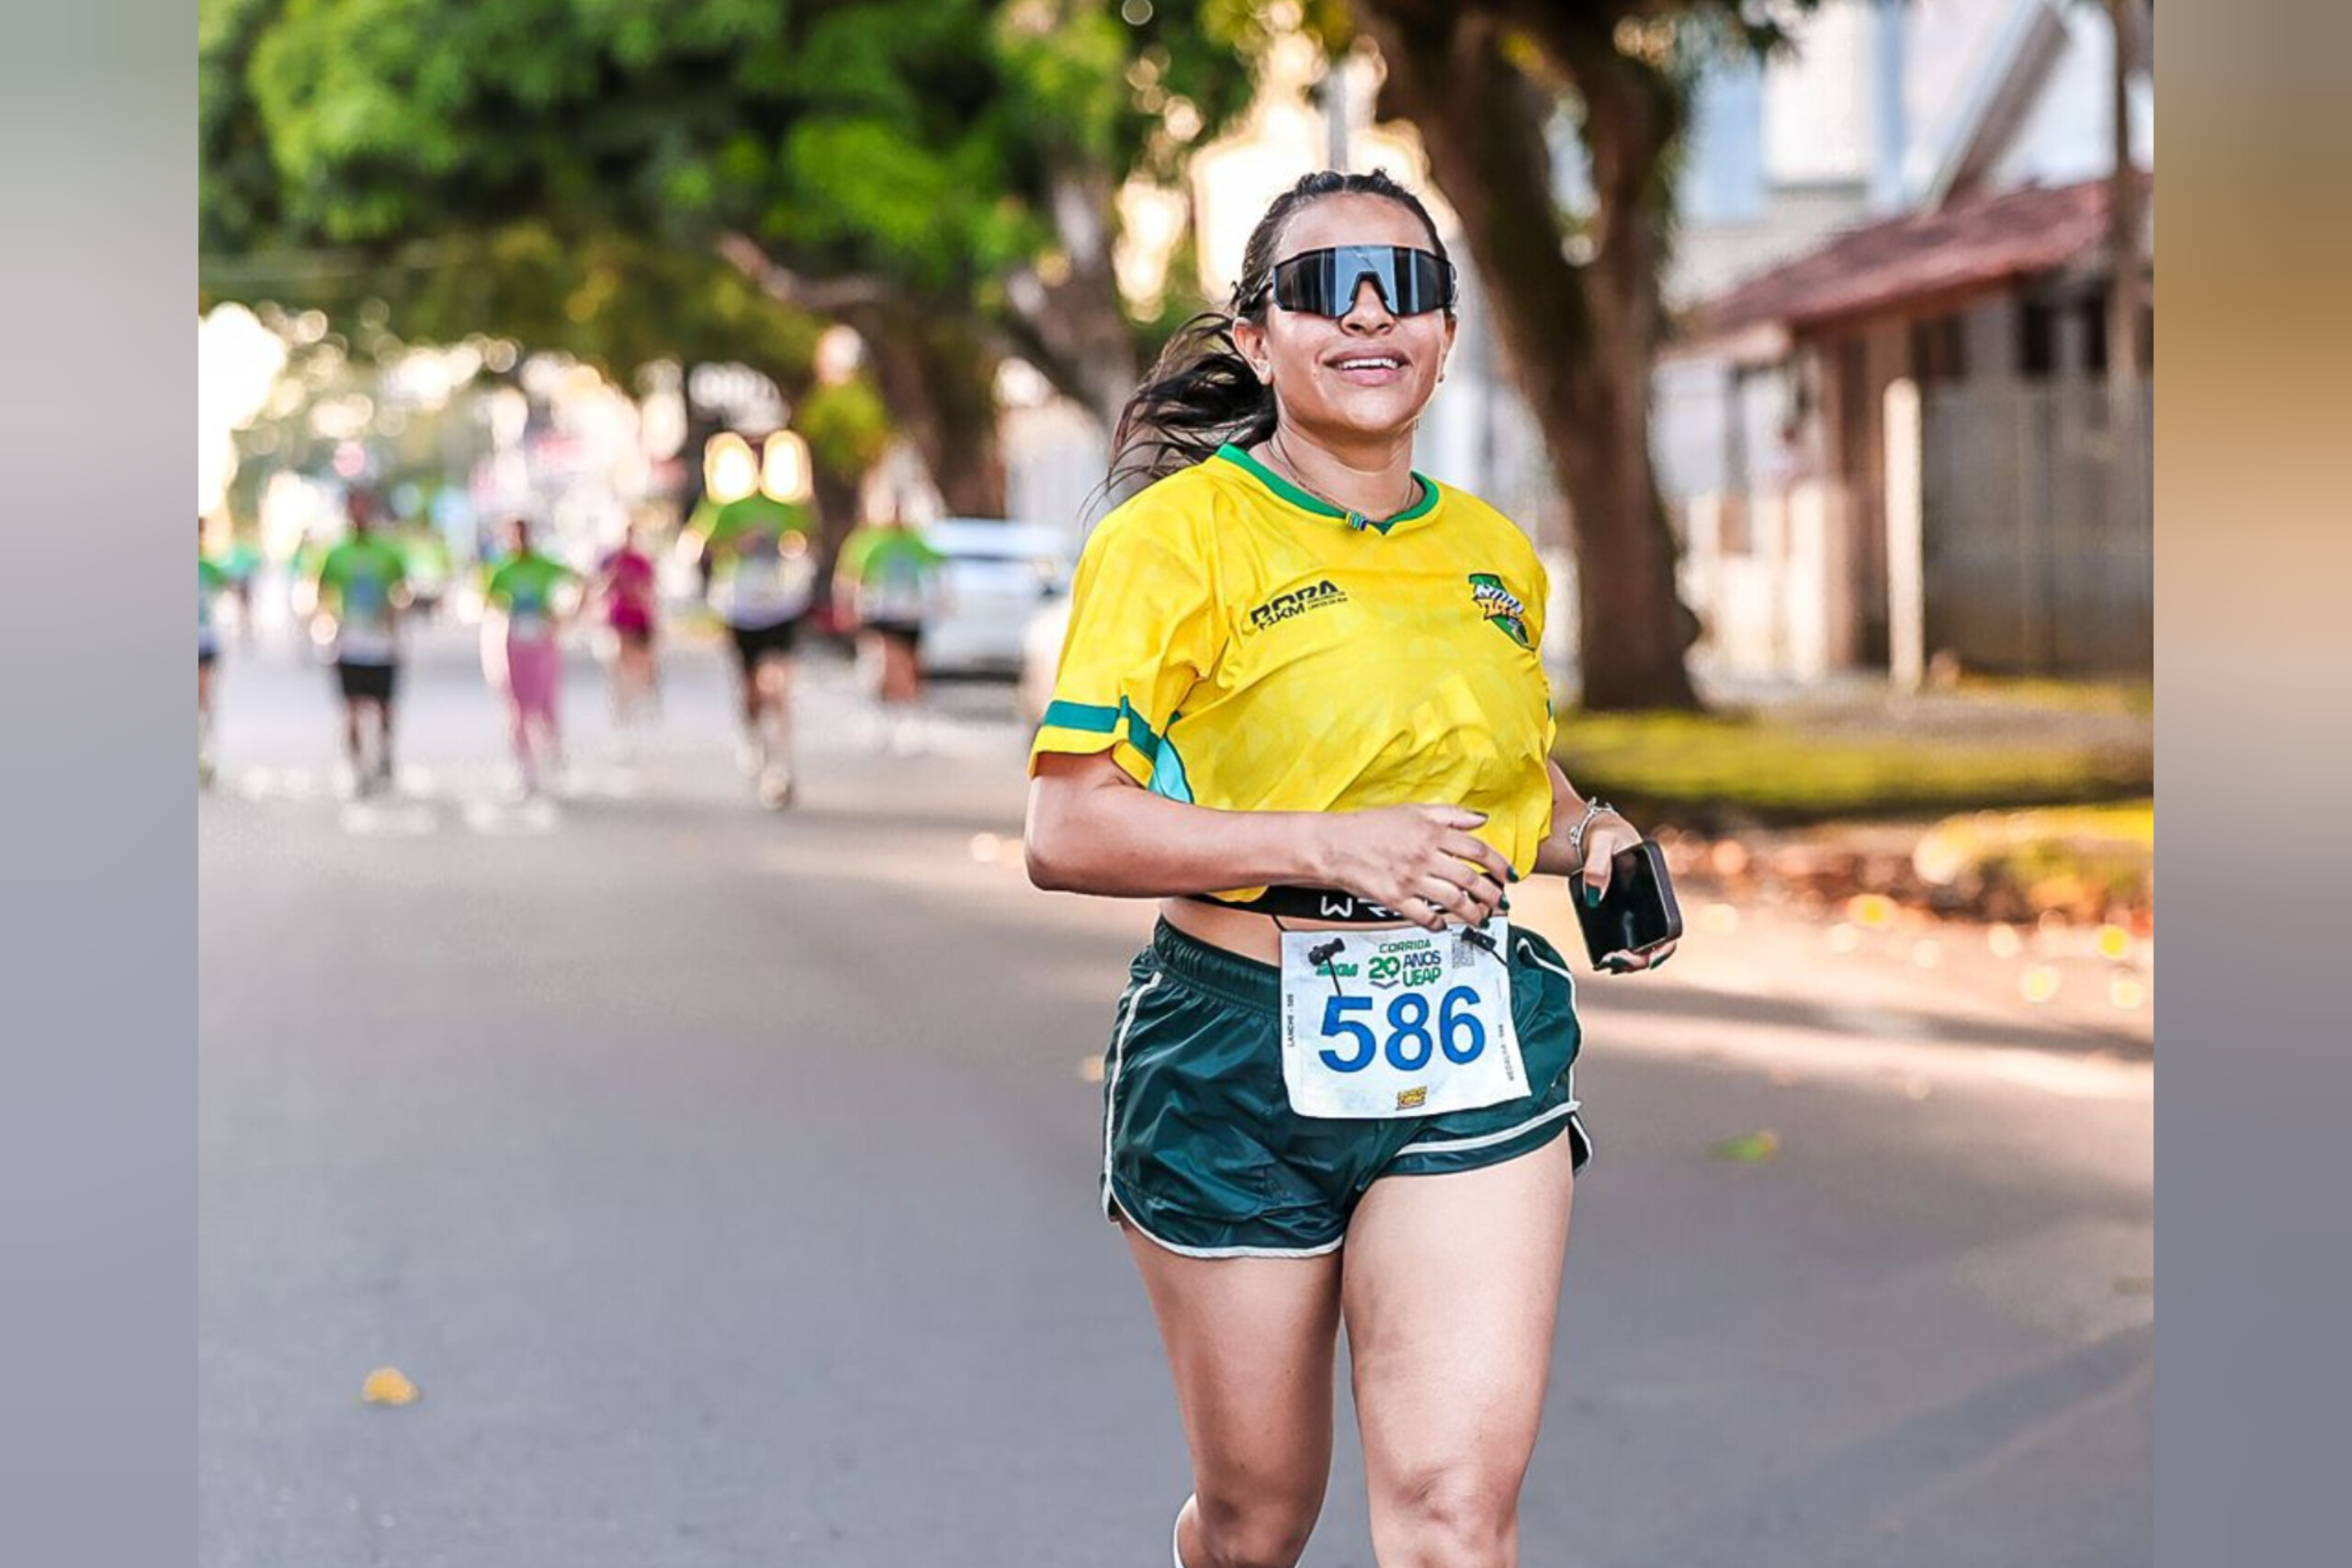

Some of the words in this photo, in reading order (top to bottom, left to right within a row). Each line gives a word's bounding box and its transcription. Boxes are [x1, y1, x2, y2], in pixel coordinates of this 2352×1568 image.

[1379, 939, 1431, 953] CORRIDA
[1368, 956, 1400, 979] 20
[1403, 950, 1442, 969] ANOS
[1403, 966, 1442, 987] UEAP
[1318, 986, 1486, 1073] 586
